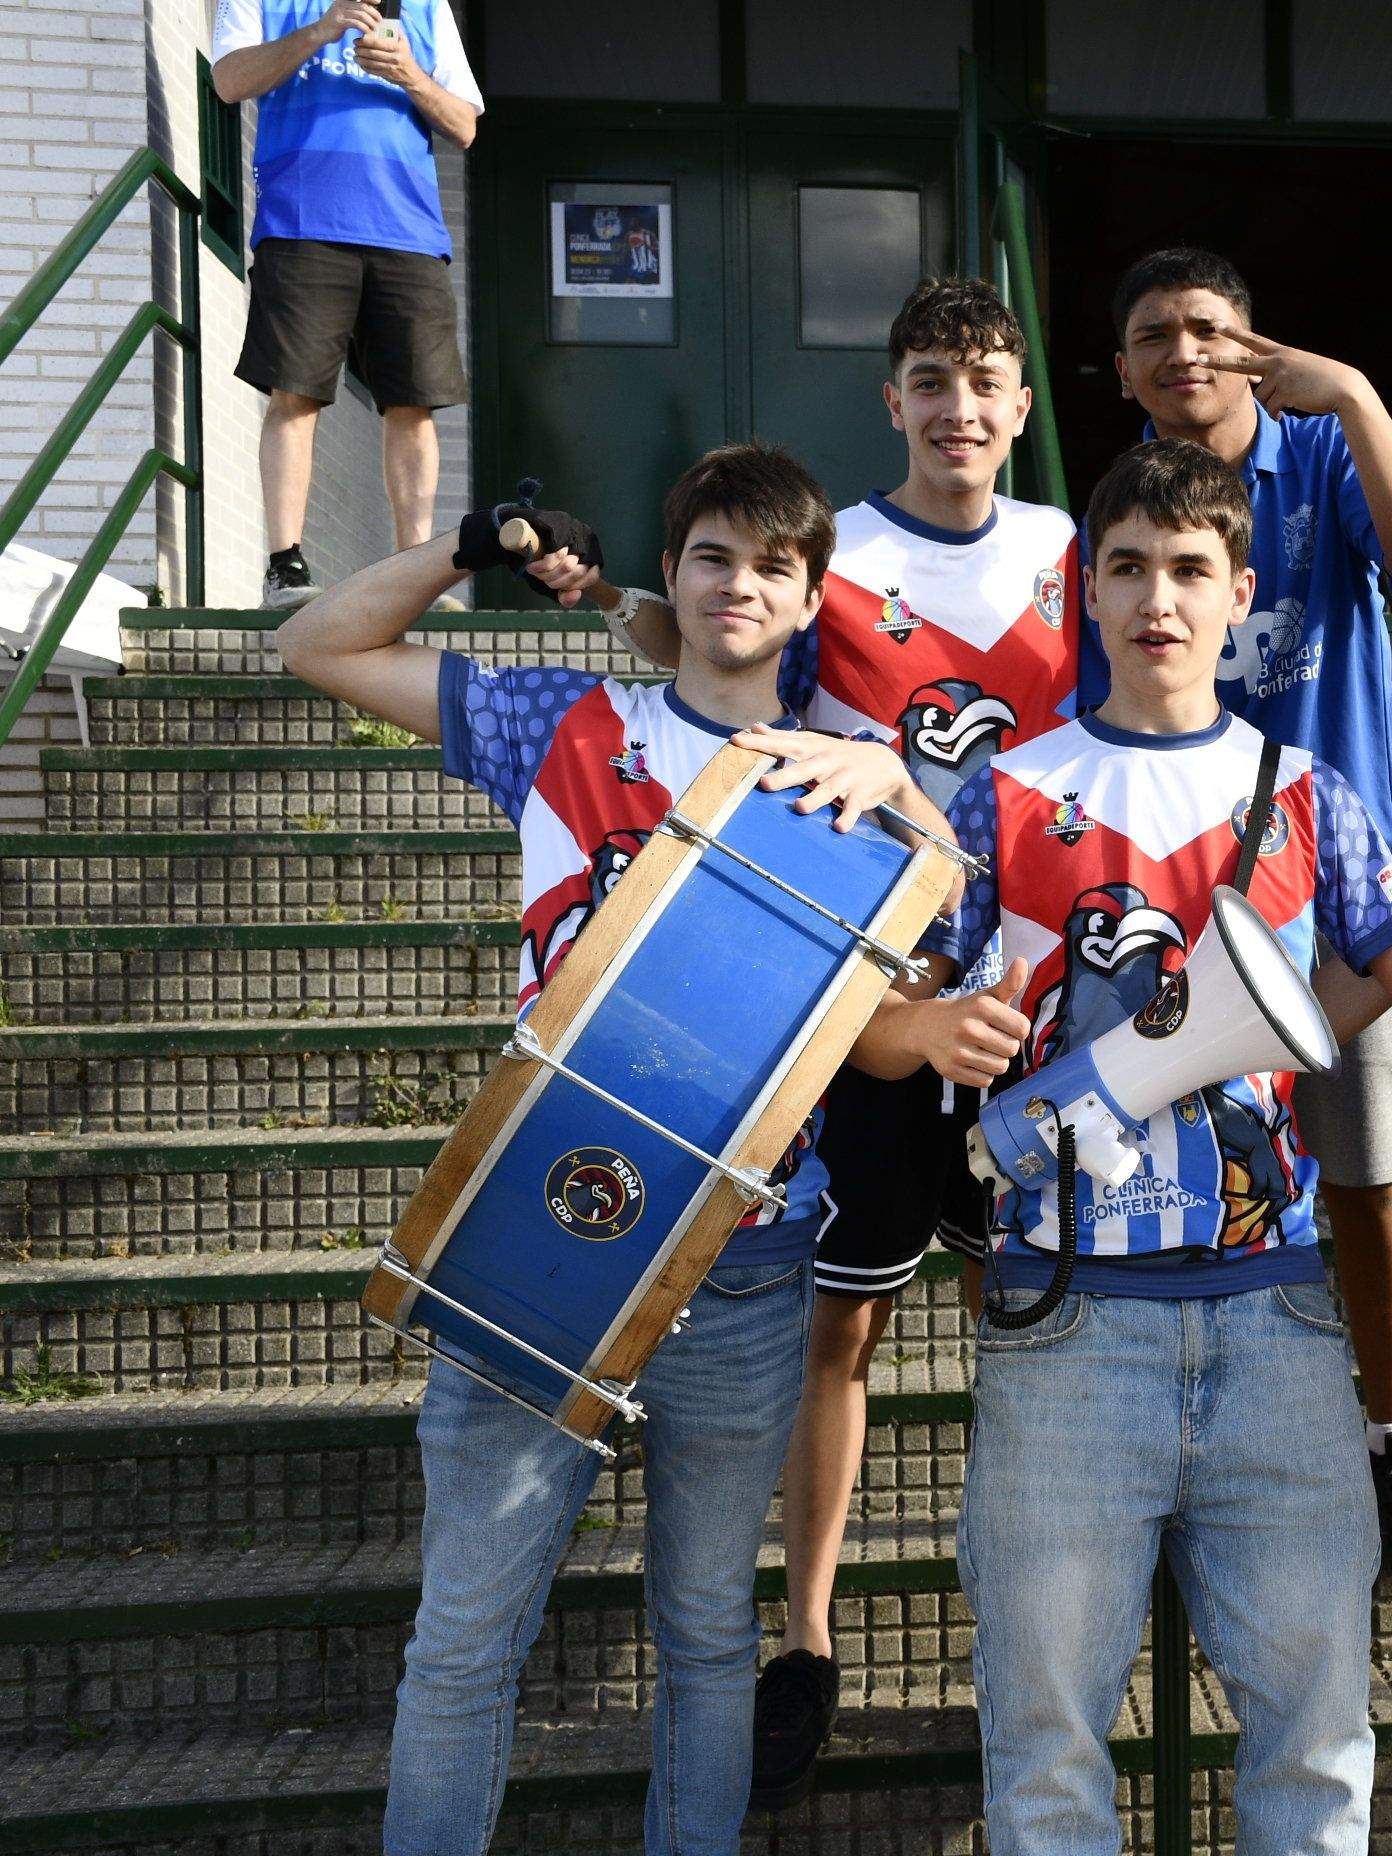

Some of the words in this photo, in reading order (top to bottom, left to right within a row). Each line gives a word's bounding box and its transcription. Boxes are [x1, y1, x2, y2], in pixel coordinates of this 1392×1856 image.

[1046, 822, 1094, 834] EQUIPADEPORTE
[1166, 1009, 1183, 1032] CDP
[611, 1158, 640, 1200] PEÑA
[551, 1197, 573, 1223] CDP
[1083, 1190, 1207, 1222] PONFERRADA
